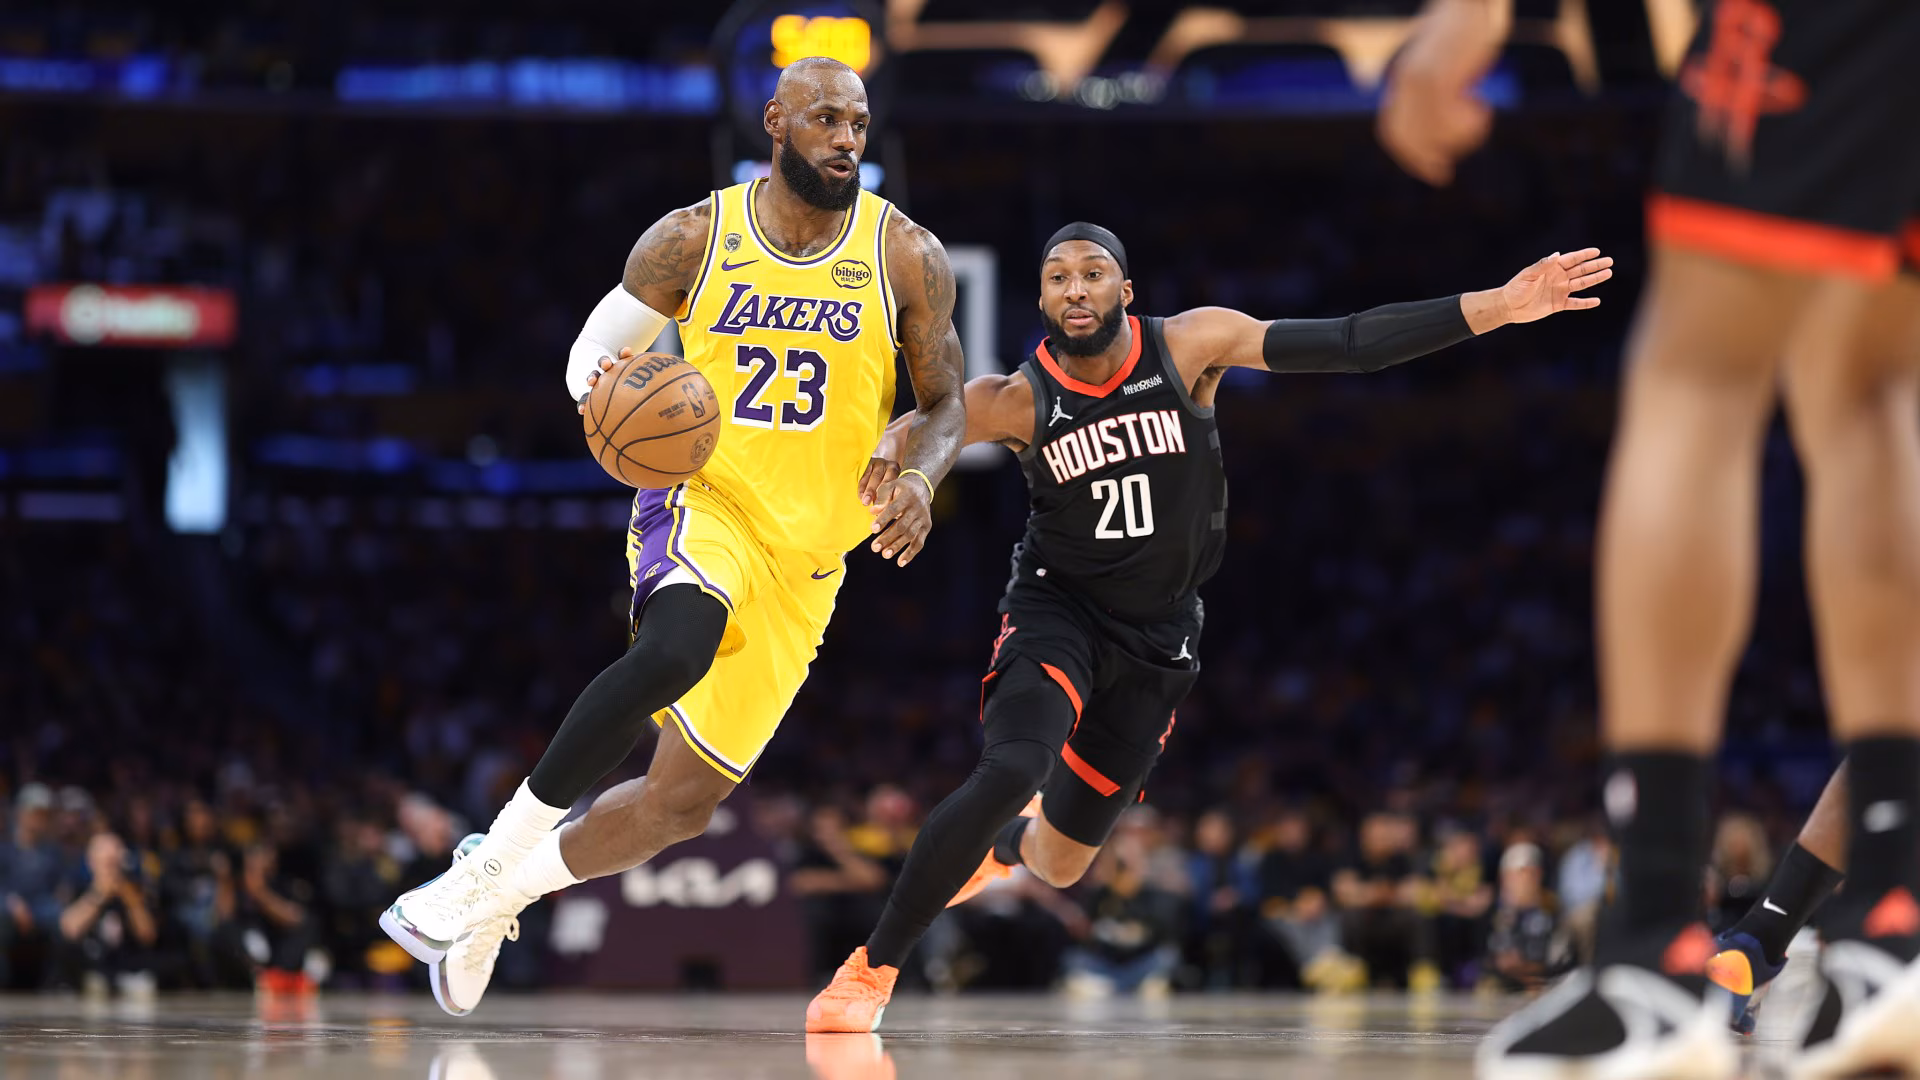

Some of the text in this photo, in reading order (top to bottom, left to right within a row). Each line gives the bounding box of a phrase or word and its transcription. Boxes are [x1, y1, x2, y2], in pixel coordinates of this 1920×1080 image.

[835, 266, 870, 281] bibigo
[709, 283, 864, 342] LAKERS
[732, 344, 829, 432] 23
[1041, 410, 1186, 485] HOUSTON
[1090, 473, 1155, 540] 20
